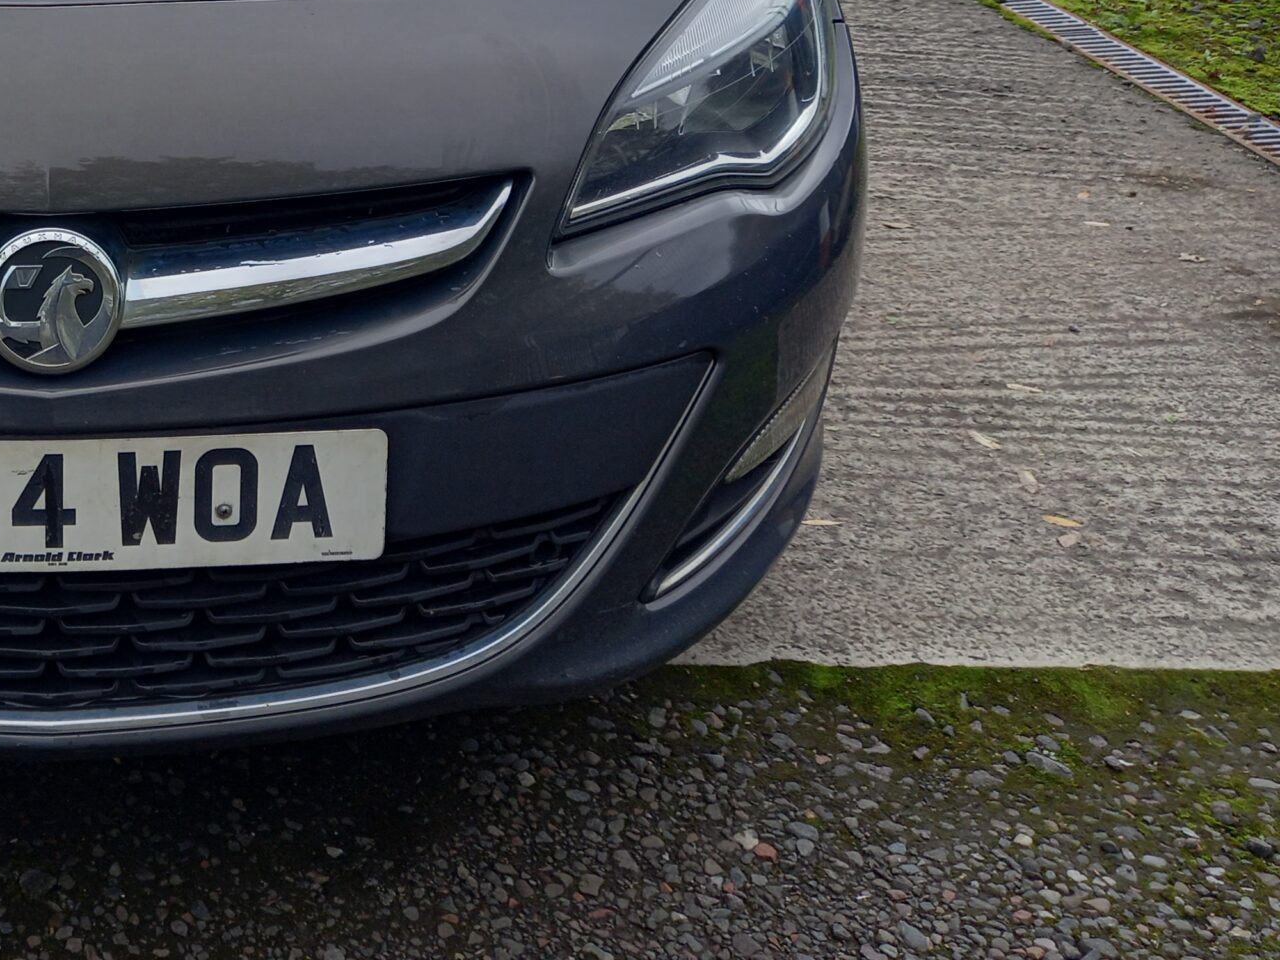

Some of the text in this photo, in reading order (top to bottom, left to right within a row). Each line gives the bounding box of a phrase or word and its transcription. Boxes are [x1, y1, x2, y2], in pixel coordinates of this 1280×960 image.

[0, 232, 101, 260] VAUXHALL
[117, 444, 333, 547] WOA
[0, 550, 115, 562] Arnold Clark
